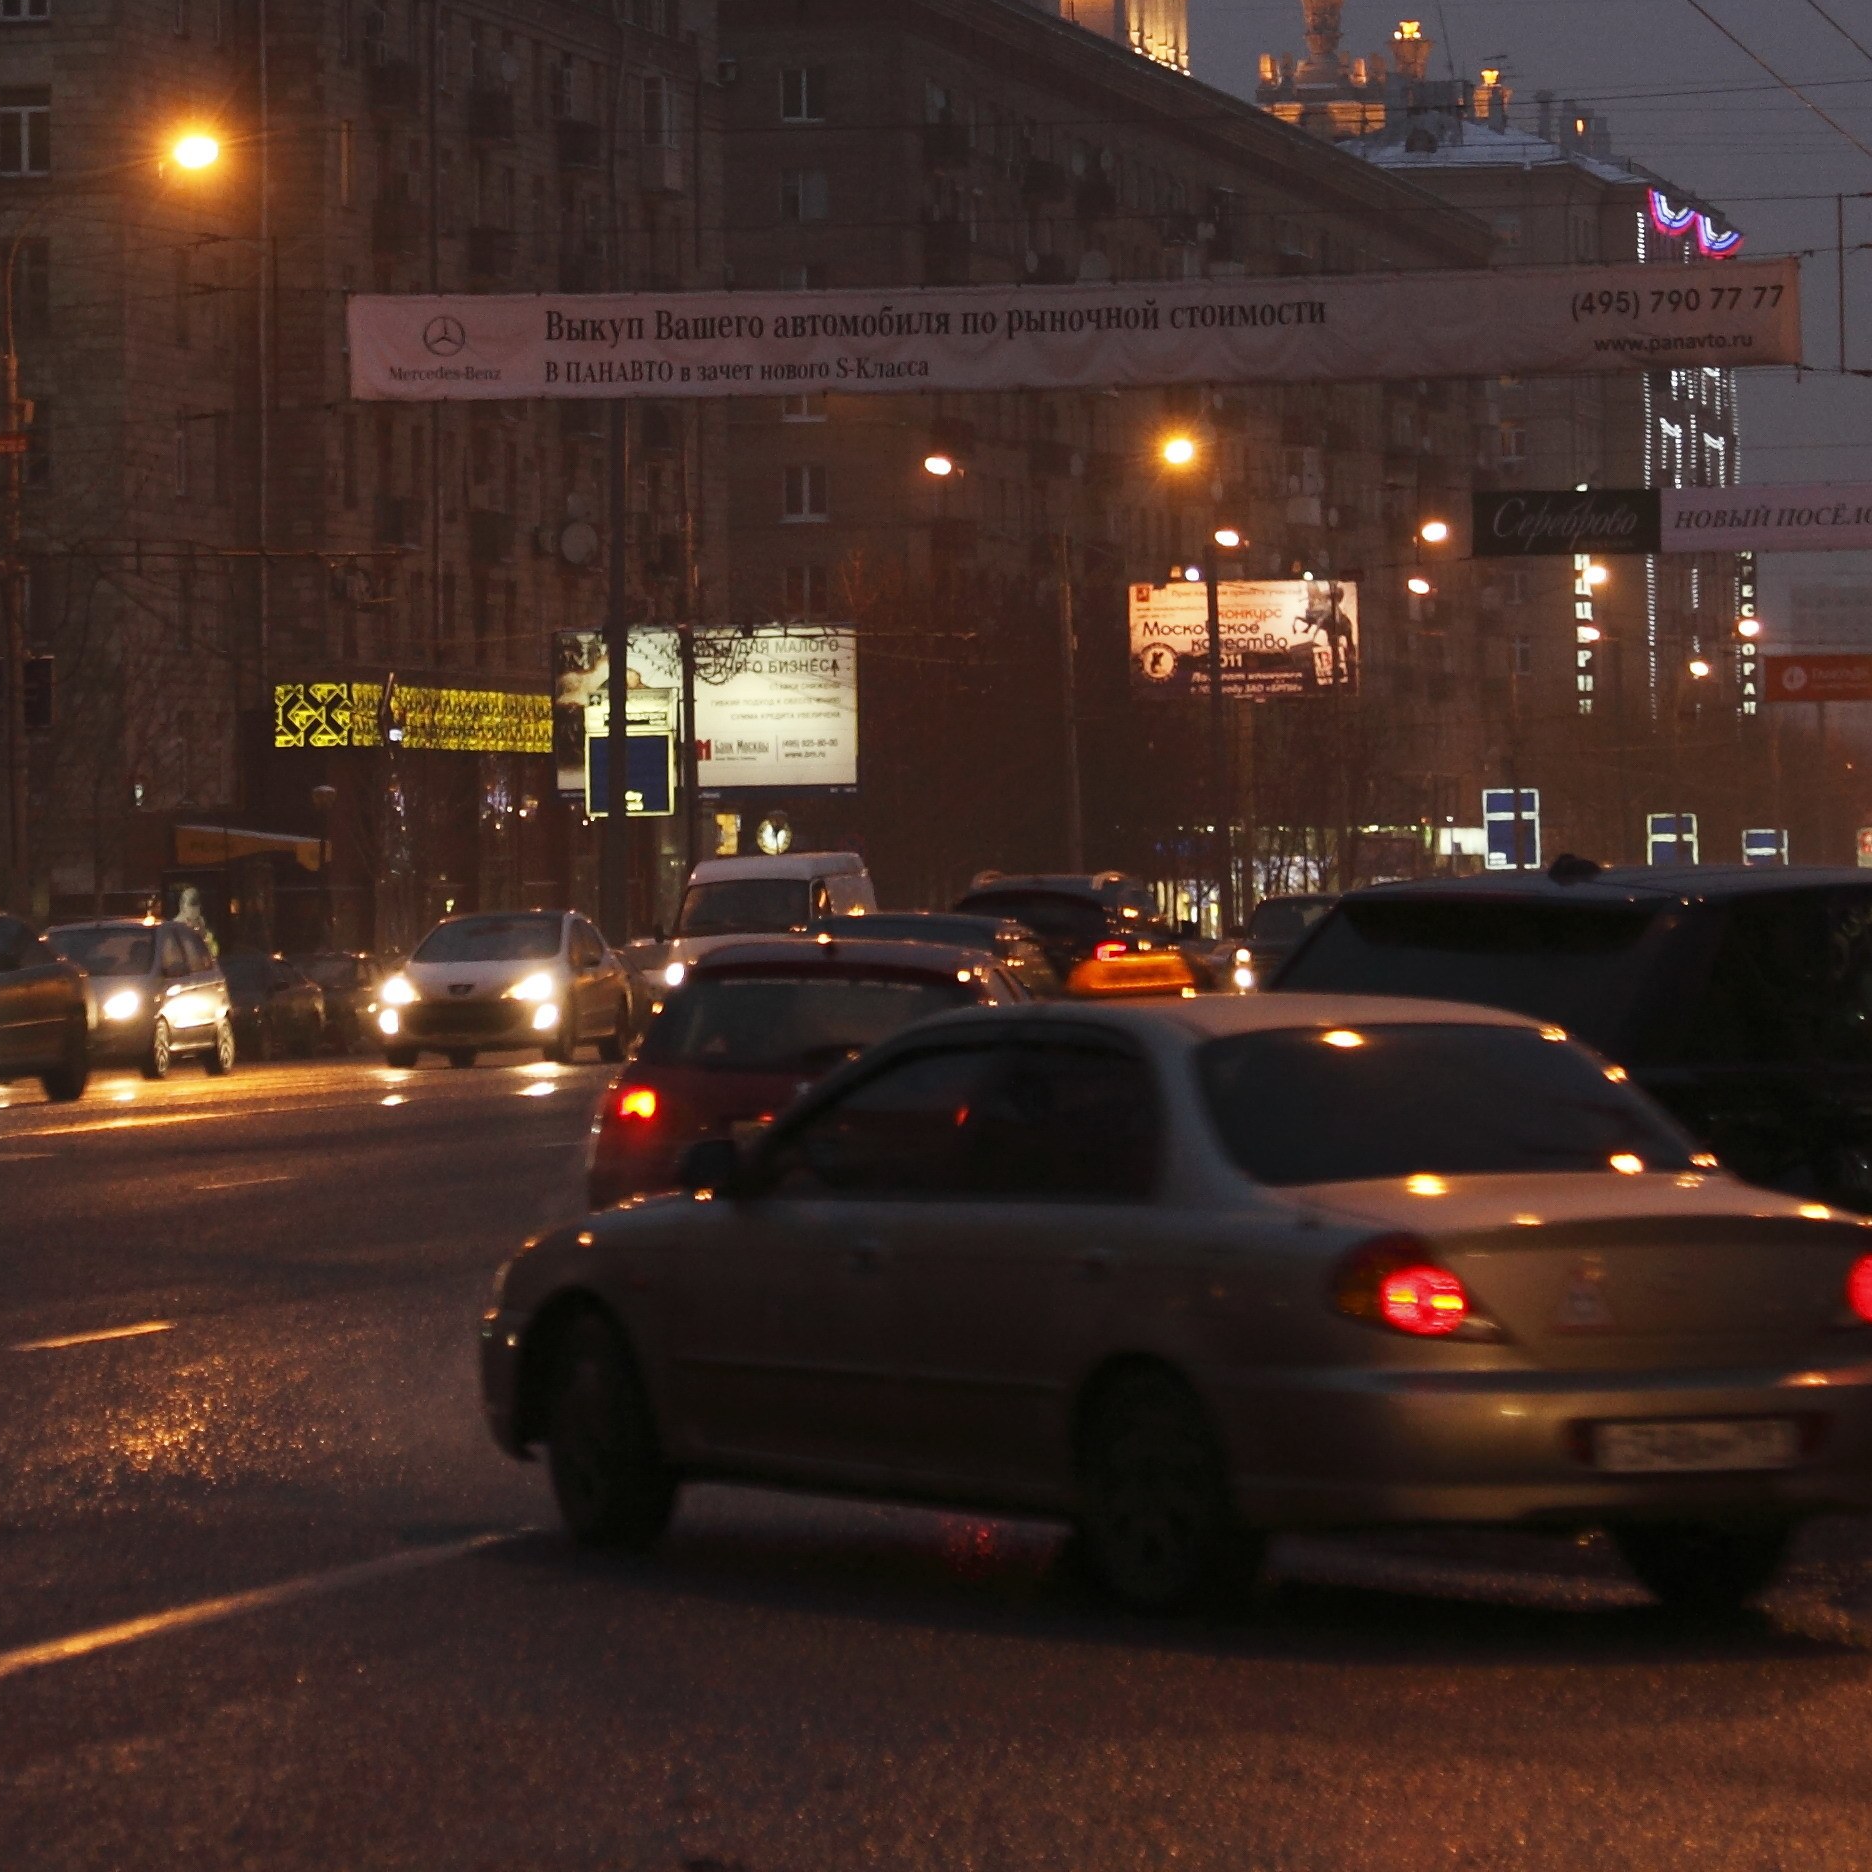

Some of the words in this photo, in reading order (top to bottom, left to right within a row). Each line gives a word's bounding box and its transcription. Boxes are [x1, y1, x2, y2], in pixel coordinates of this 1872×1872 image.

[1571, 289, 1640, 322] (495)
[1650, 288, 1701, 313] 790
[1710, 287, 1742, 310] 77
[1753, 285, 1784, 309] 77
[544, 310, 645, 348] Выкуп
[654, 309, 764, 341] Вашего
[773, 305, 950, 338] автомобиля
[960, 313, 997, 335] по
[1007, 300, 1160, 339] рыночной
[1169, 301, 1326, 328] стоимости
[1594, 333, 1753, 354] www.panavto.ru
[388, 366, 502, 381] Mercedes-Benz
[544, 361, 558, 383] В
[566, 360, 673, 384] ПАНАВТО
[680, 365, 691, 382] в
[697, 362, 753, 381] зачет
[760, 360, 830, 380] нового
[836, 356, 929, 380] S-Класса
[1674, 504, 1770, 529] НОВЫЙ
[1142, 621, 1260, 638] Москоское
[774, 637, 840, 653] МАЛОГО
[1191, 632, 1289, 653] каество
[1740, 565, 1757, 716] РЕСОРАН
[767, 658, 841, 673] БИЗНЕСА
